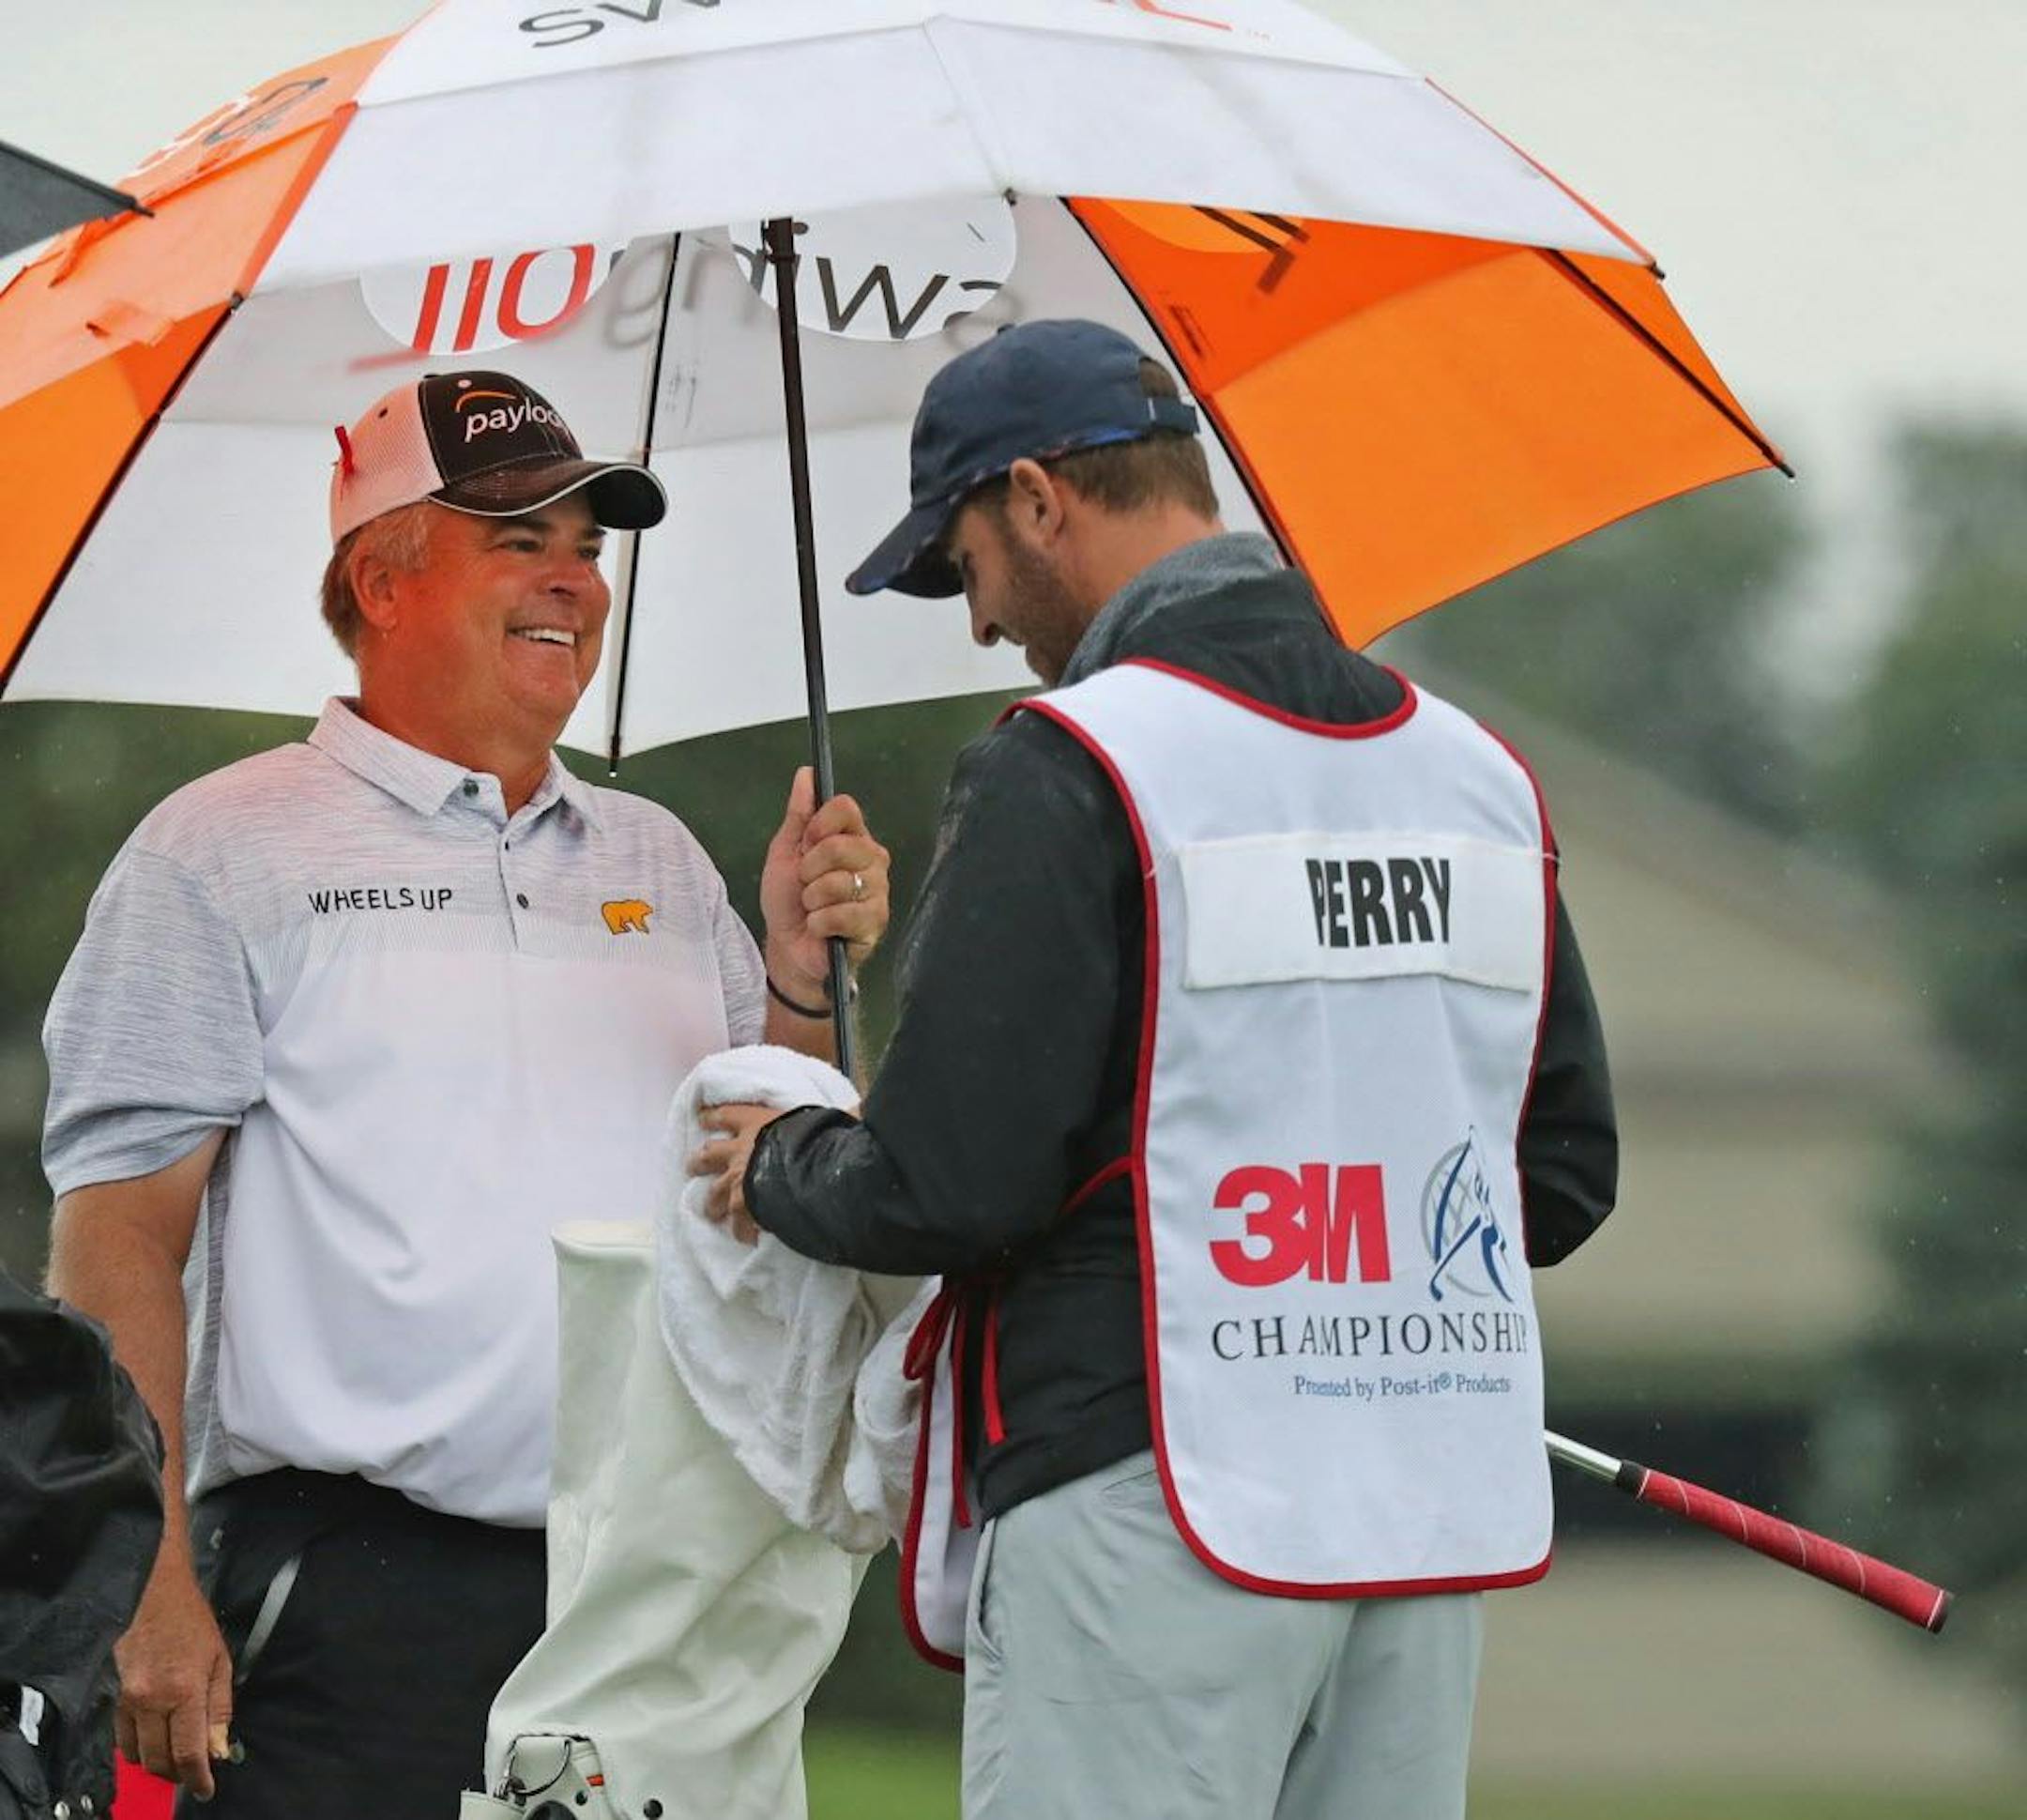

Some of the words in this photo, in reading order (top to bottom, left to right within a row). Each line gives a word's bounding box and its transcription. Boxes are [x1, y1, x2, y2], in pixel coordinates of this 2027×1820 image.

[1305, 857, 1451, 948] PERRY
[1209, 1162, 1392, 1288] 3M
[1354, 1377, 1375, 1401] by
[1455, 1372, 1511, 1393] Products
